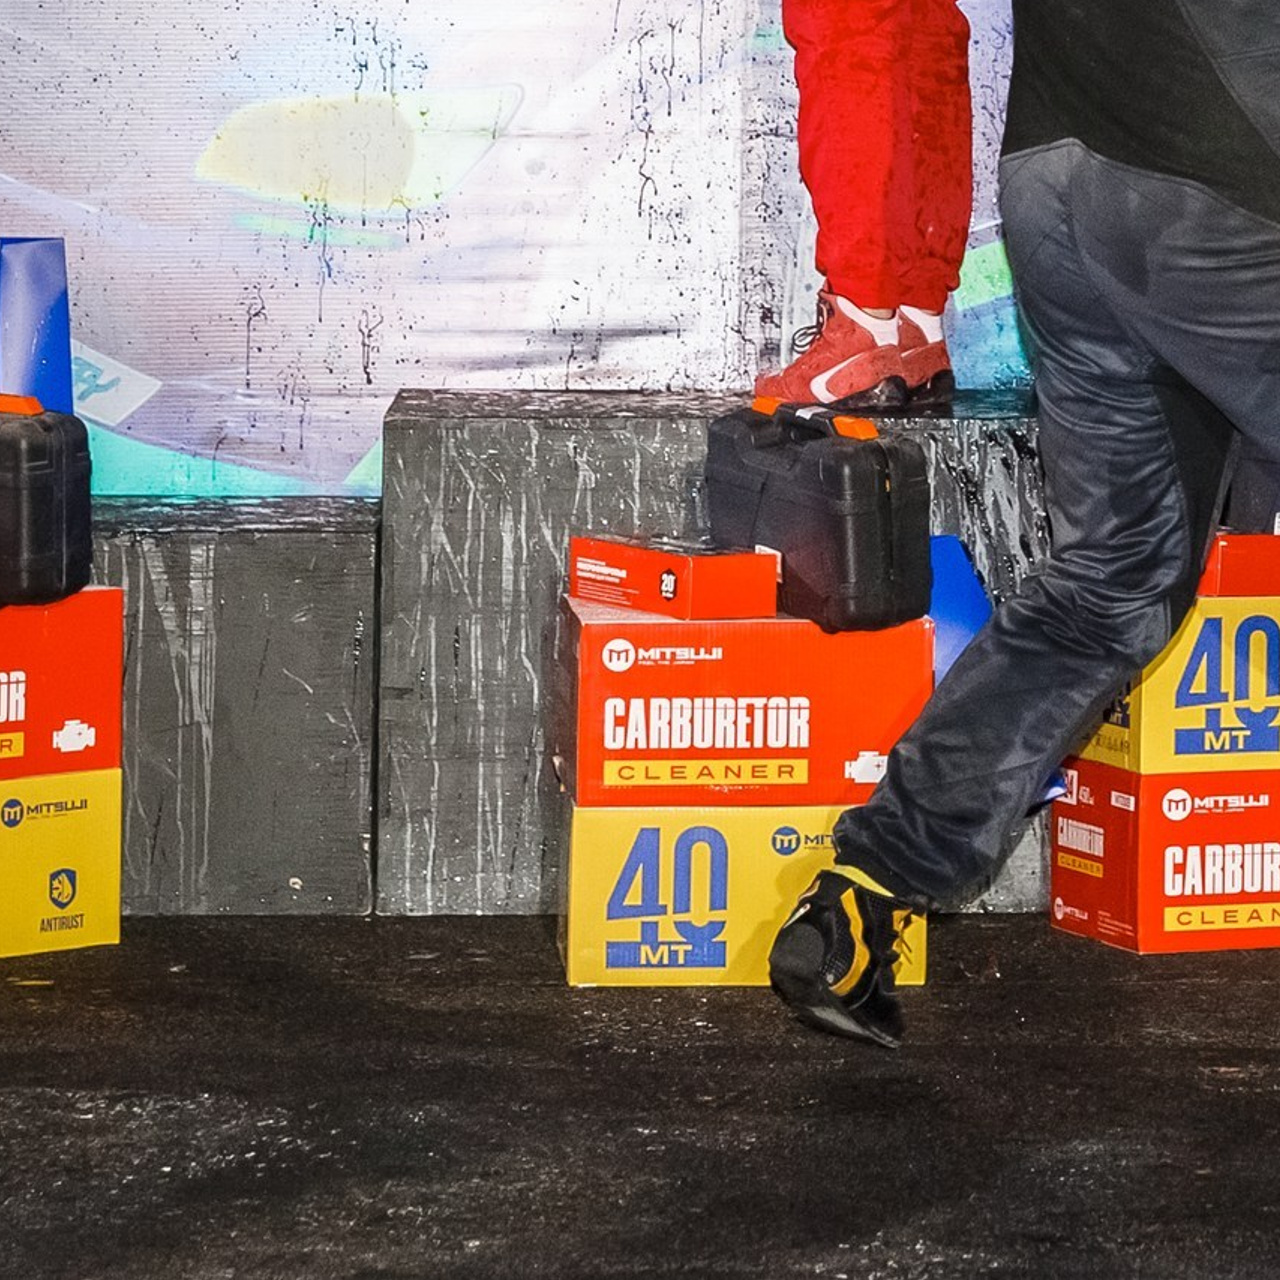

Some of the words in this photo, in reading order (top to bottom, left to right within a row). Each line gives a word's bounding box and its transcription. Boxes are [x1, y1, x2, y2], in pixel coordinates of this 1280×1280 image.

[638, 647, 723, 660] MITSUJI
[603, 696, 810, 750] CARBURETOR
[1204, 730, 1251, 751] MT
[617, 764, 796, 781] CLEANER
[26, 799, 88, 816] MITSUJI
[1193, 793, 1270, 809] MITSUJI
[606, 825, 728, 942] 40
[40, 913, 85, 934] ANTIRUST
[640, 944, 693, 966] MT
